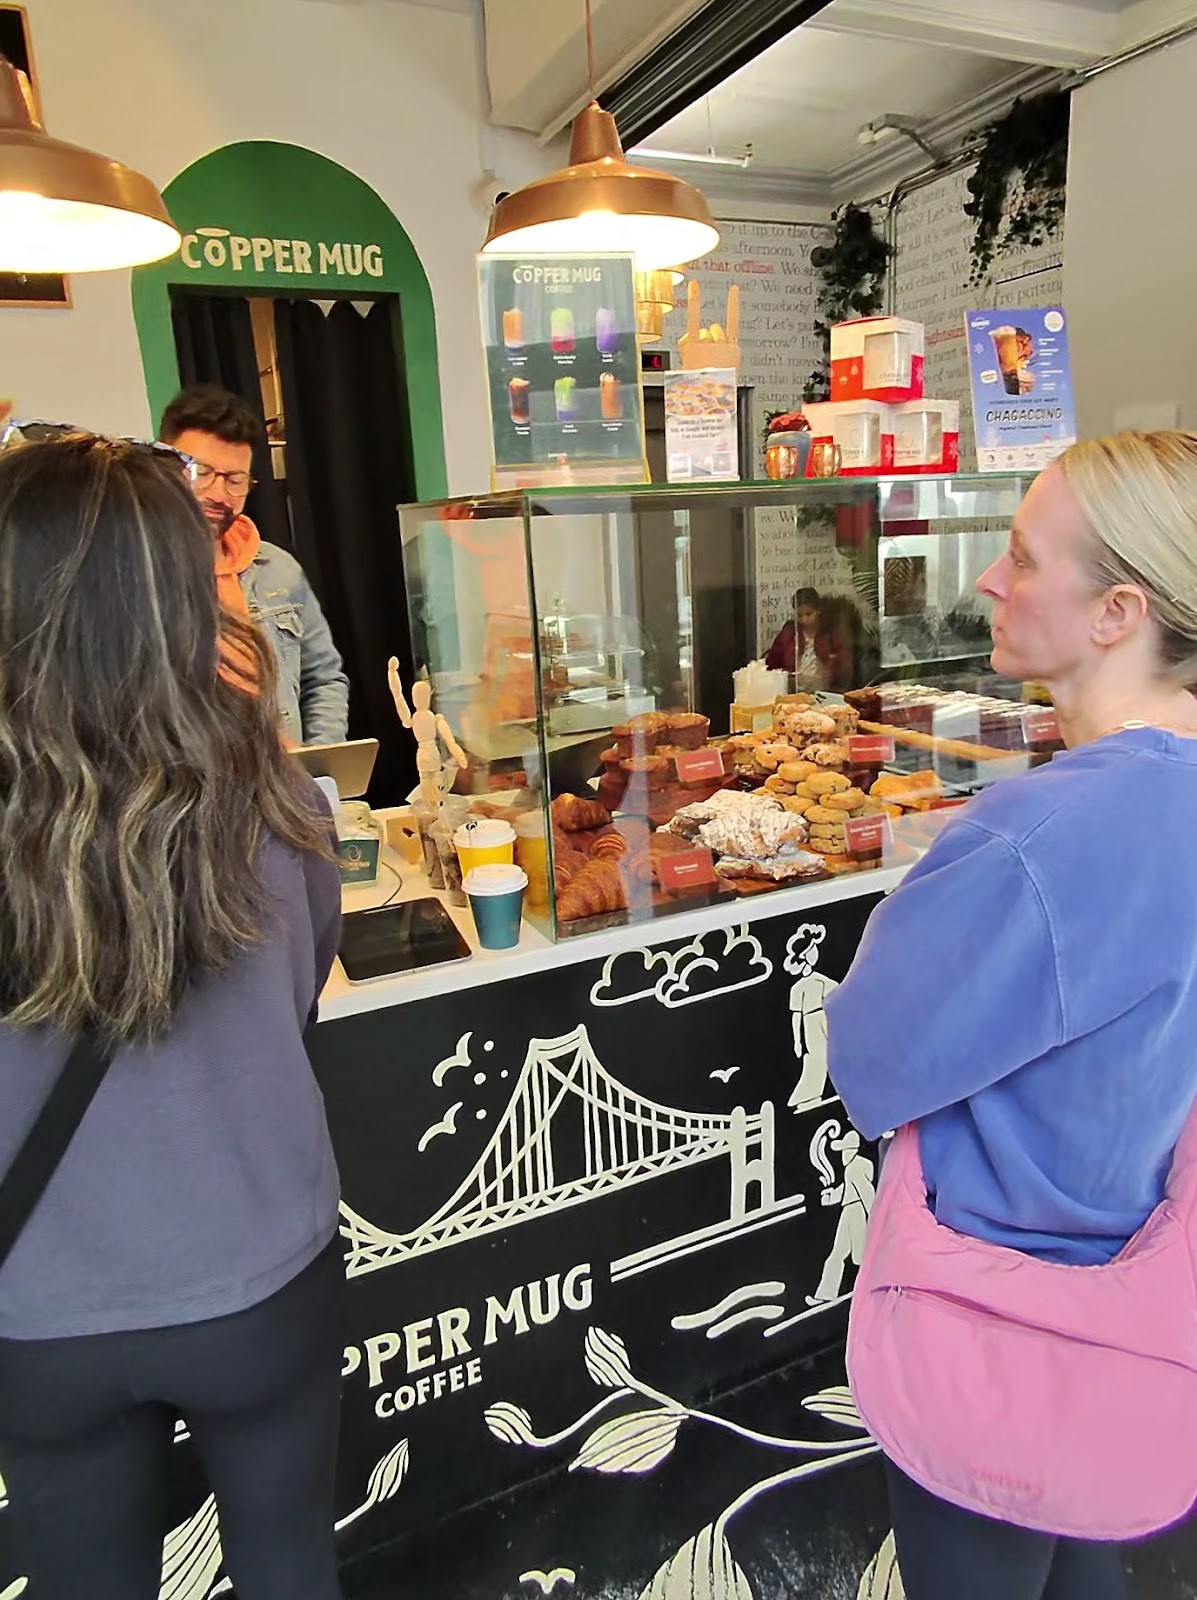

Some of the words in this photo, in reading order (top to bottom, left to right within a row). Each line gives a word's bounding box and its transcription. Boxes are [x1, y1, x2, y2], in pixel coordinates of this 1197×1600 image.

[788, 226, 808, 239] the
[181, 229, 312, 274] COPPER
[318, 242, 384, 277] MUG
[572, 267, 601, 283] MUG
[703, 258, 729, 272] that
[781, 262, 801, 276] We
[785, 281, 813, 295] need
[752, 299, 810, 315] somebody
[766, 316, 794, 331] Let's
[751, 352, 784, 367] didn't
[483, 1263, 593, 1346] MUG
[374, 1356, 483, 1418] COFFEE
